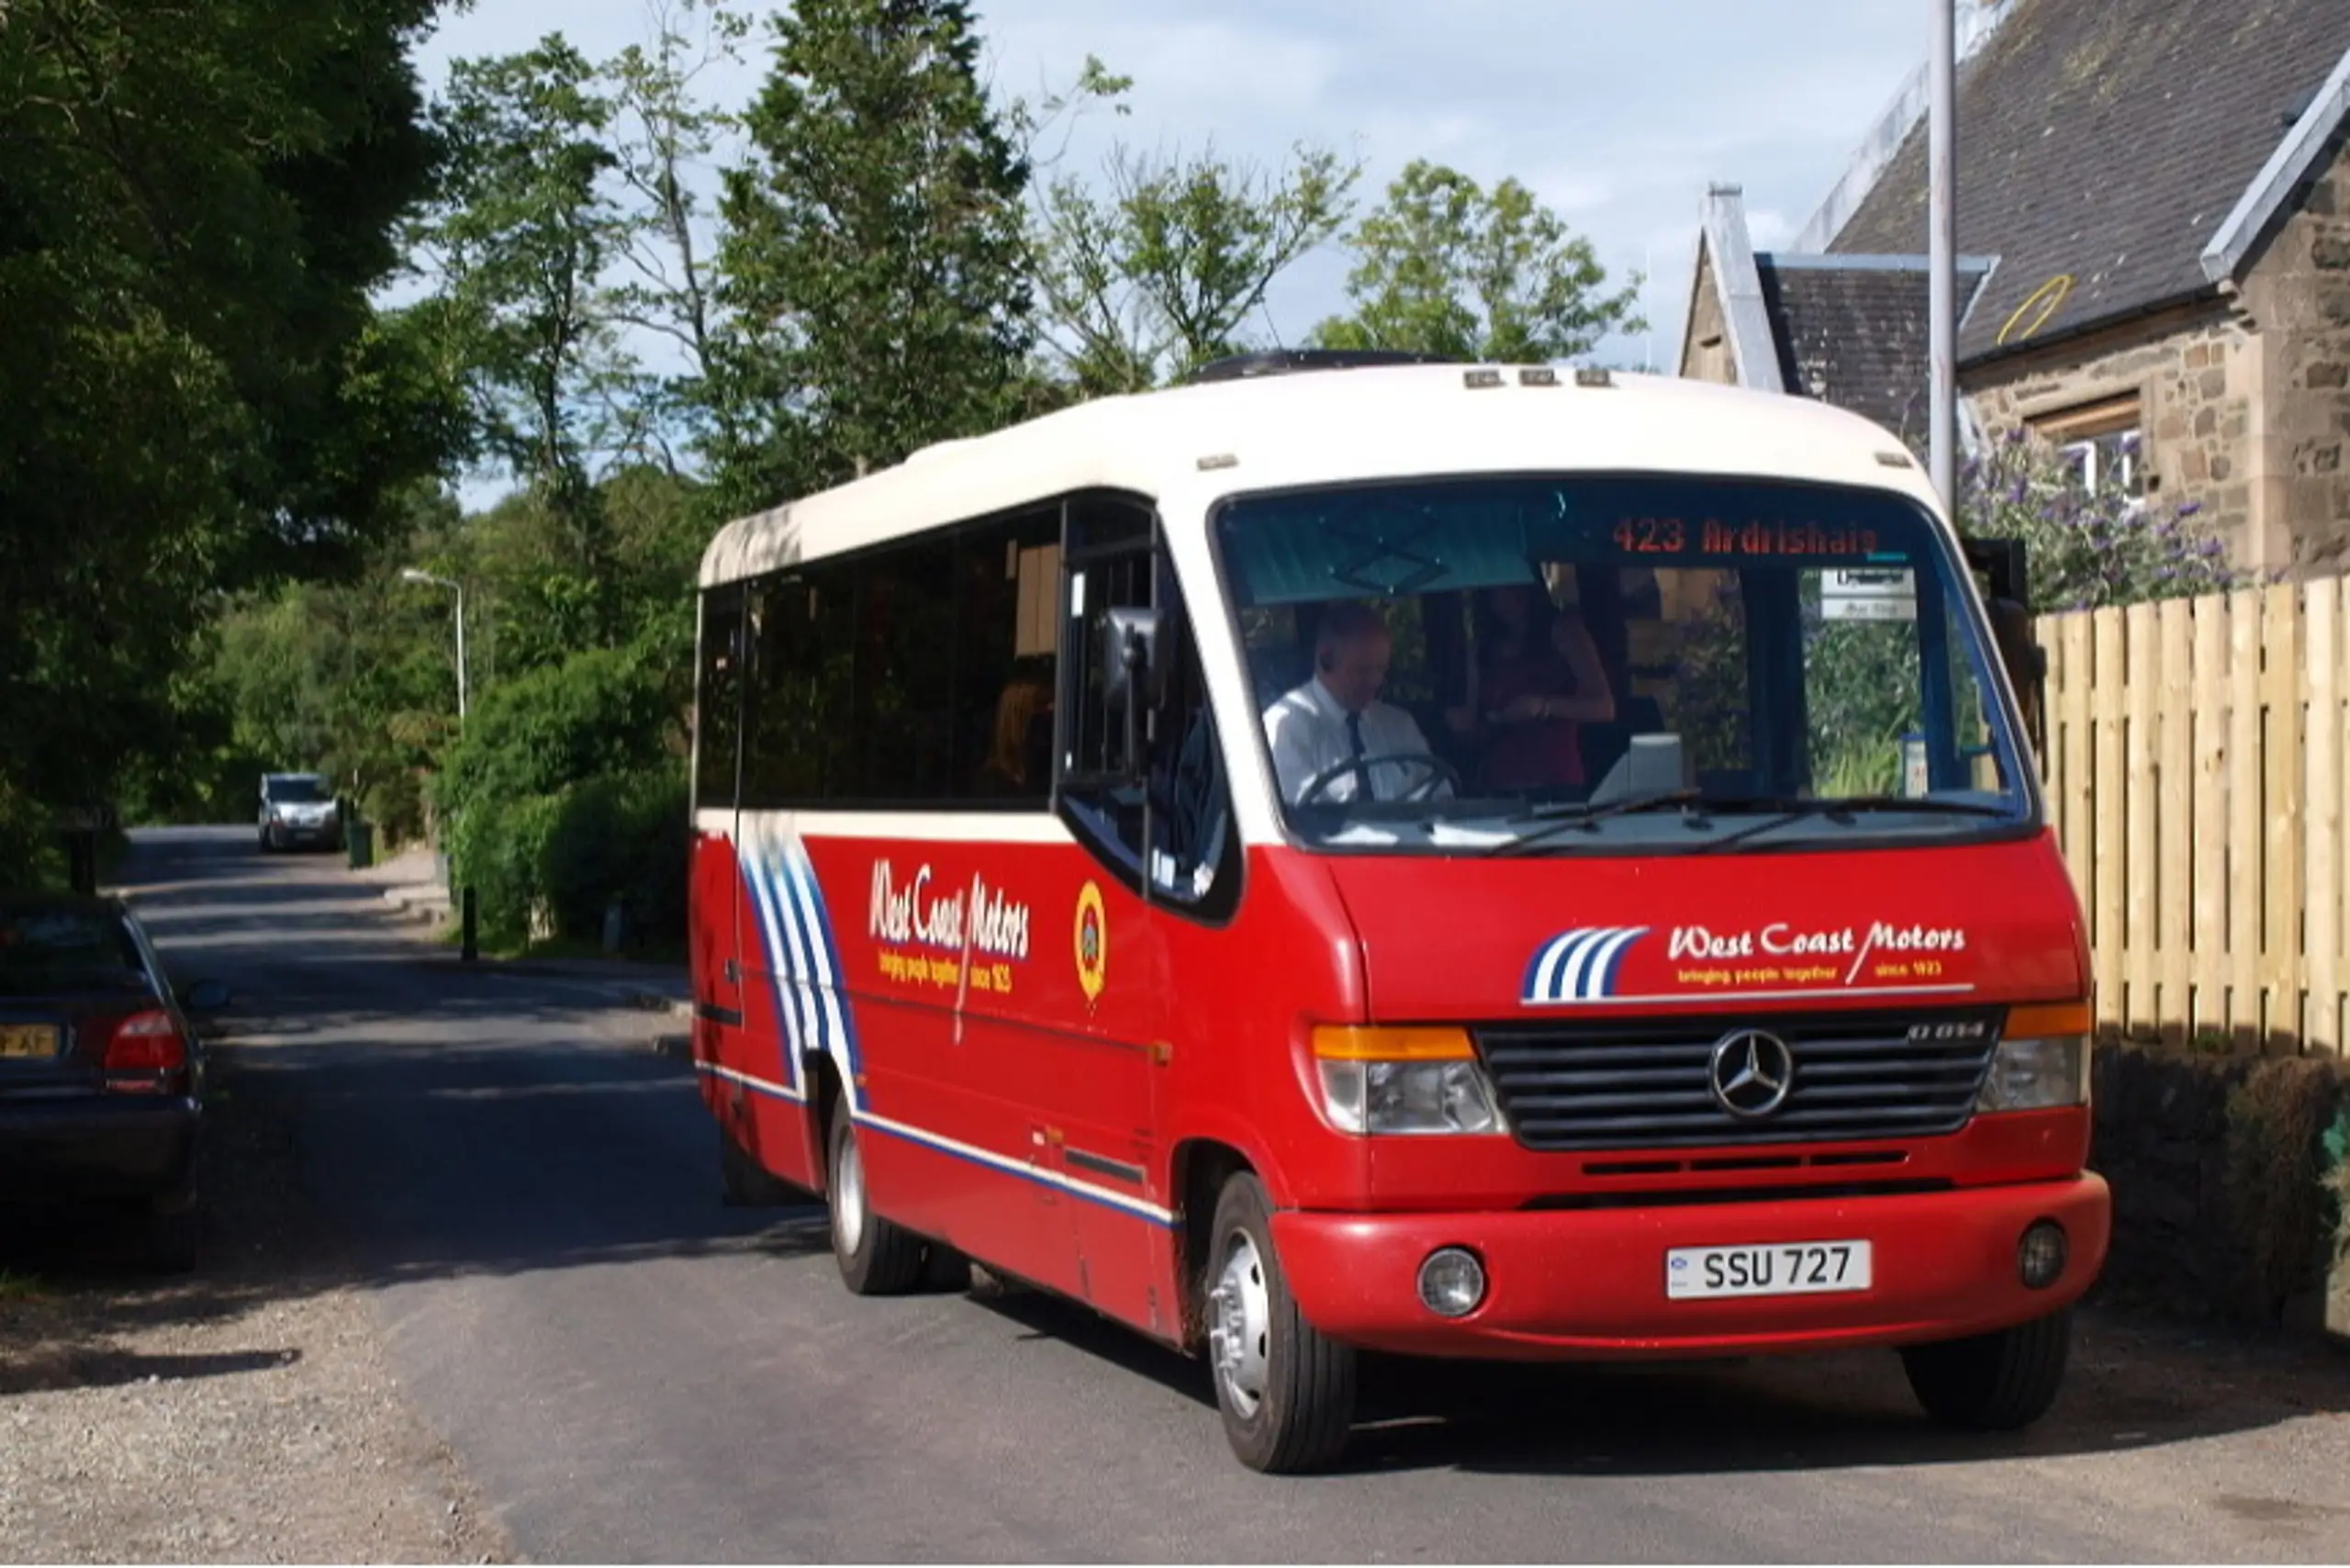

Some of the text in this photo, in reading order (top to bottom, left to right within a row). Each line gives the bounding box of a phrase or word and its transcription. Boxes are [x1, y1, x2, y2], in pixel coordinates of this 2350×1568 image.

[1613, 518, 1685, 552] 423
[869, 857, 1029, 958] West Coast Motors
[1668, 919, 1965, 960] West Coast Motors
[1705, 1247, 1851, 1289] SSU 727
